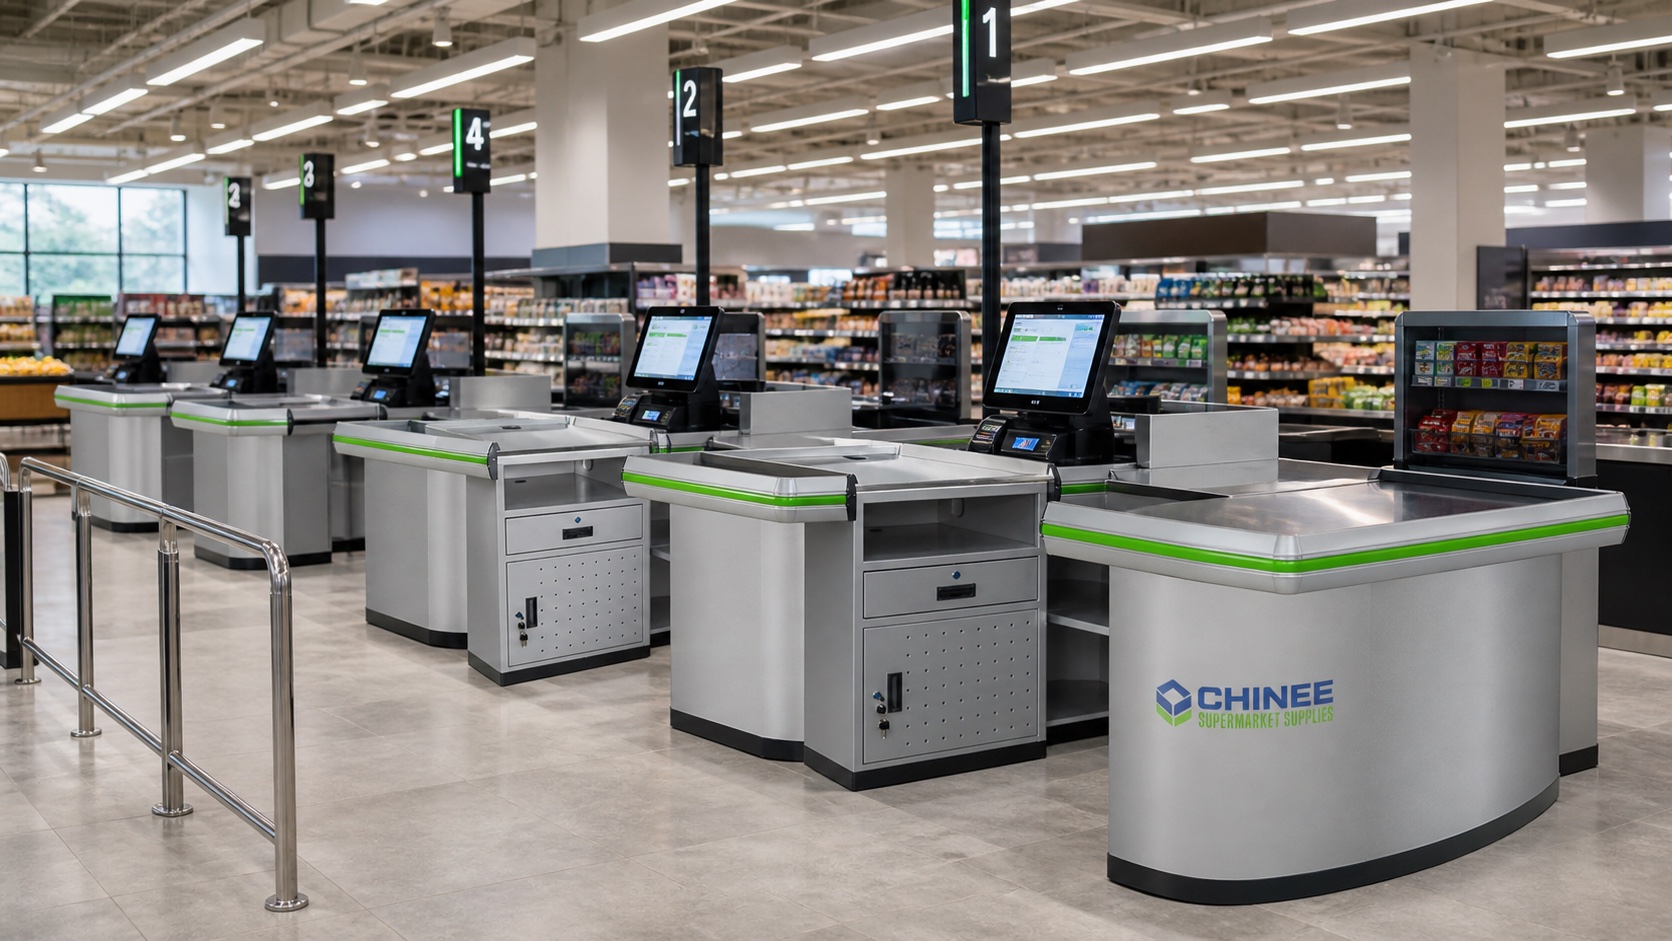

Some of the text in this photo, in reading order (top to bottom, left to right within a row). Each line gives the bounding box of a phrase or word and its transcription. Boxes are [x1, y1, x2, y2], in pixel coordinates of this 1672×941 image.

[982, 7, 997, 58] 1
[683, 80, 697, 117] 2
[466, 117, 485, 151] 4
[1197, 679, 1334, 711] CHINEE
[1198, 706, 1334, 729] SUPERMARKET SUPPLIES
